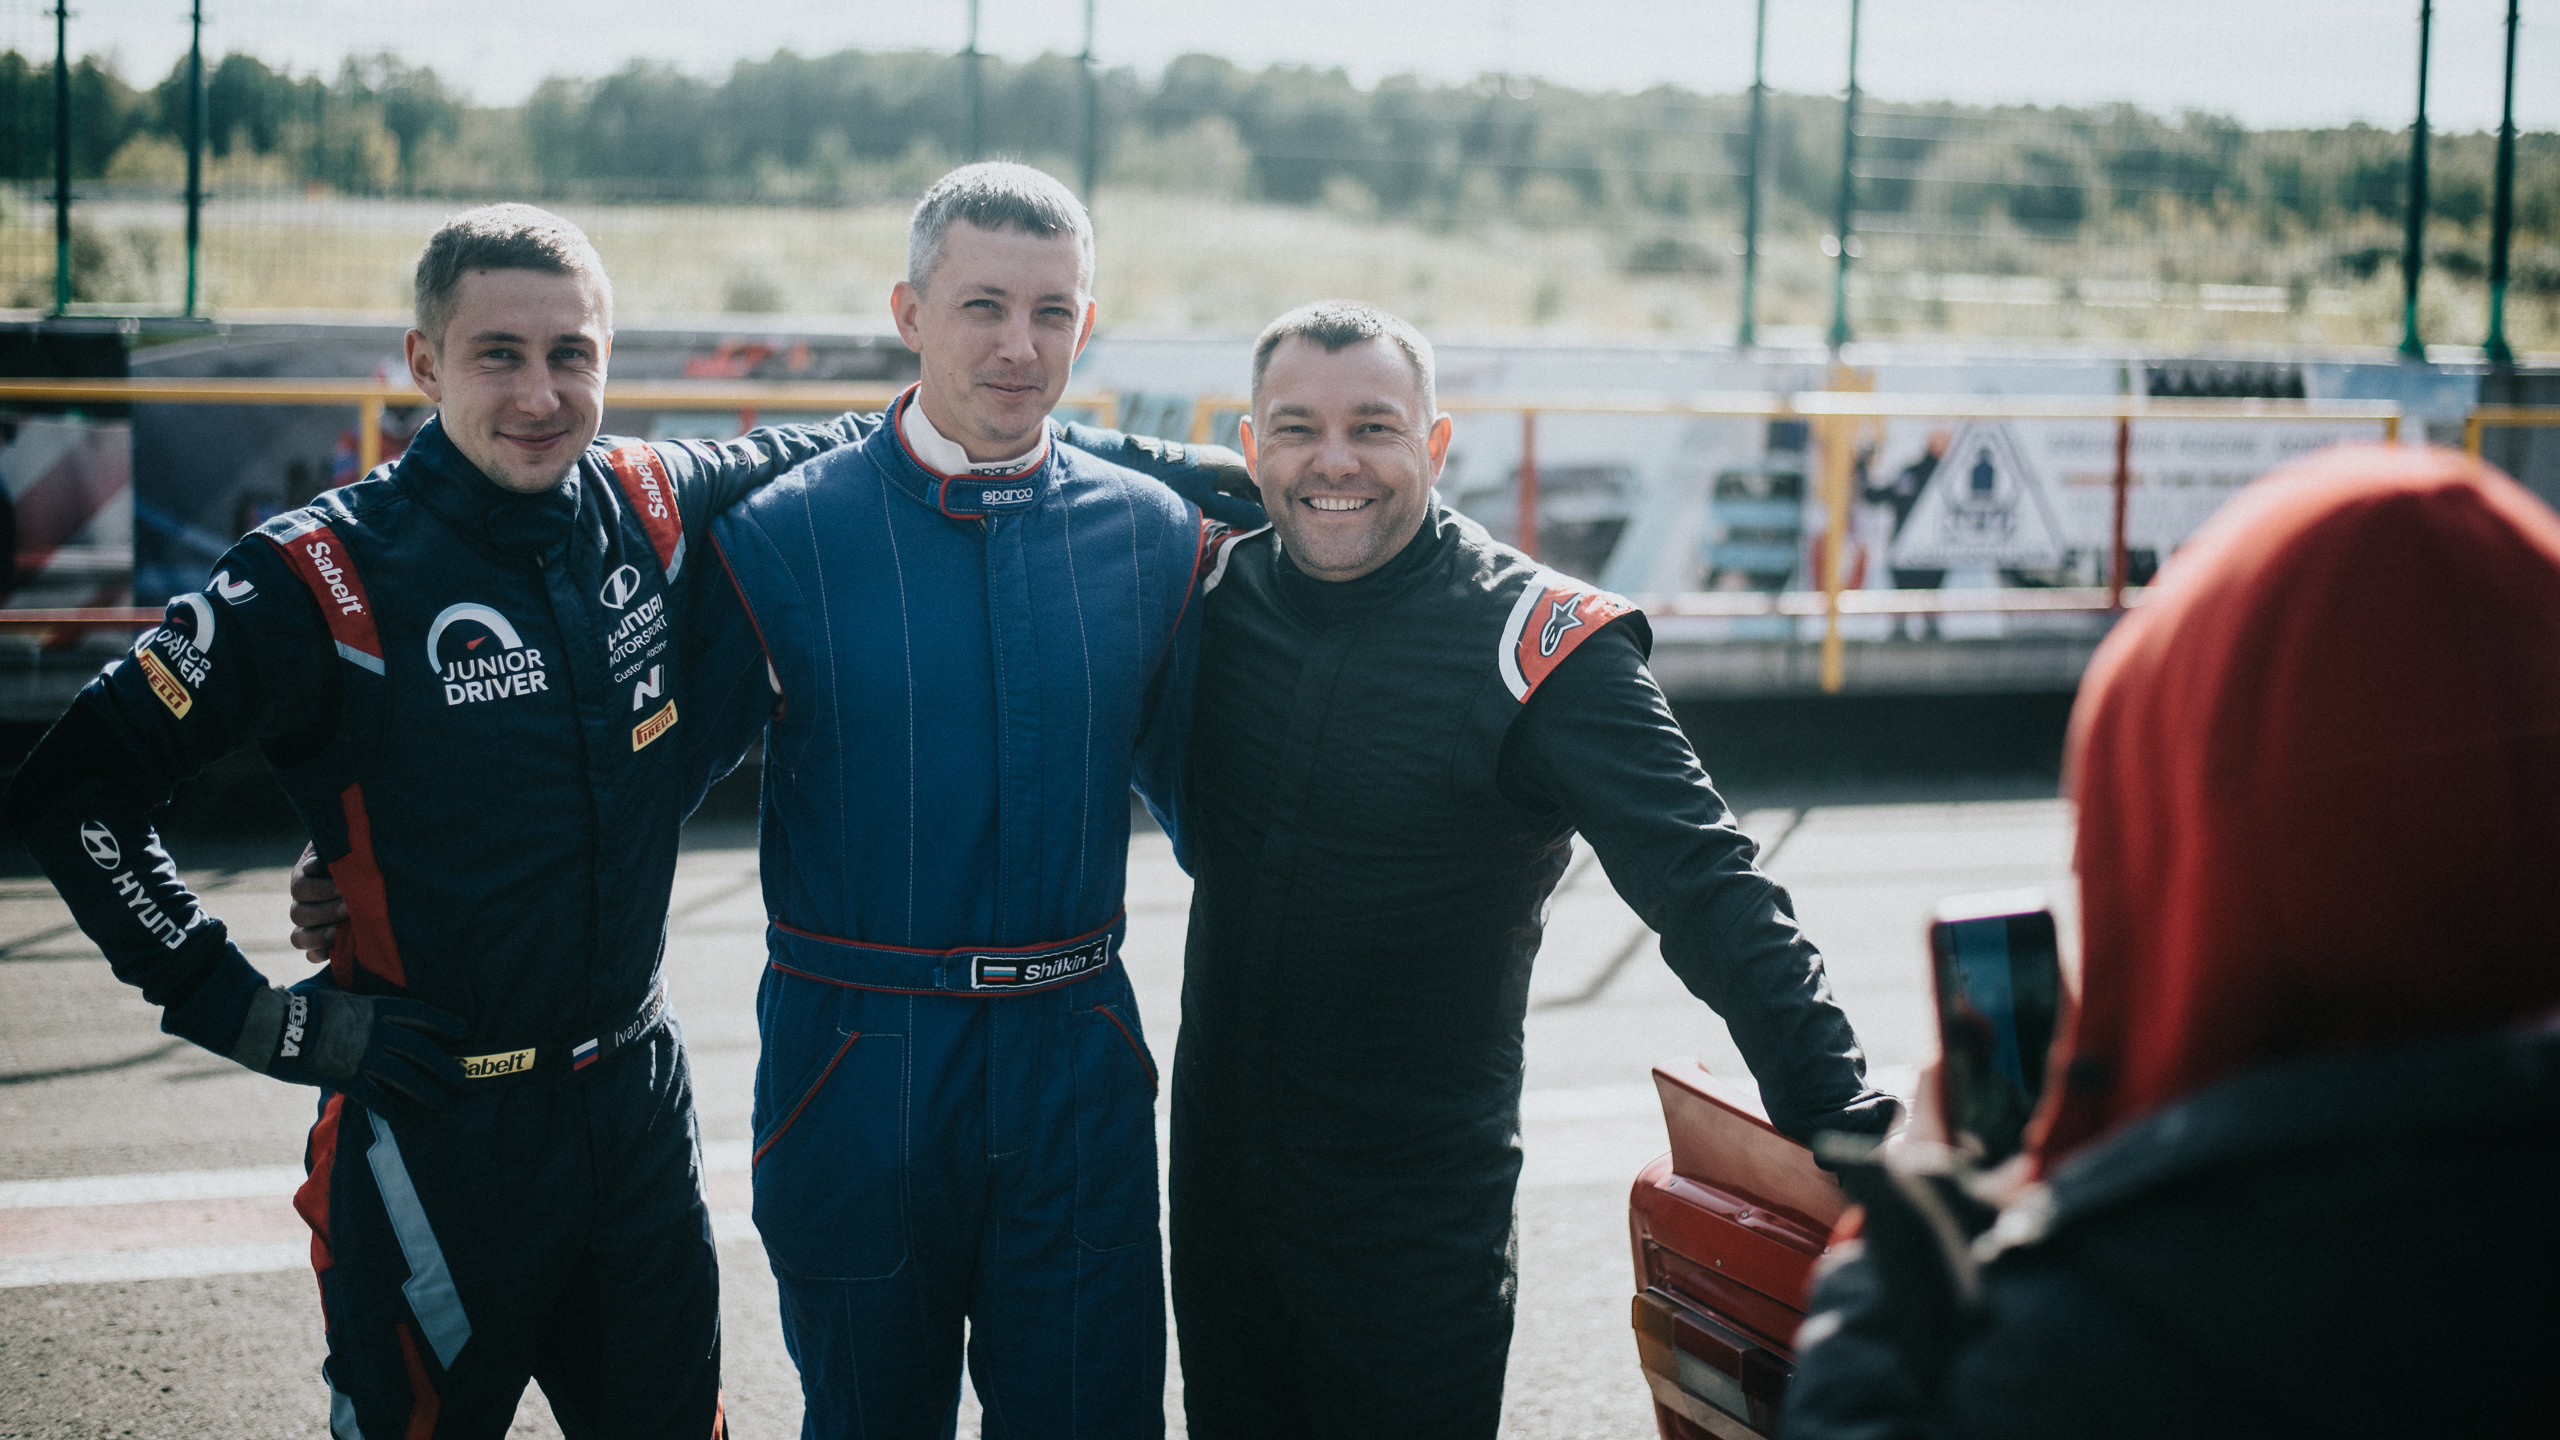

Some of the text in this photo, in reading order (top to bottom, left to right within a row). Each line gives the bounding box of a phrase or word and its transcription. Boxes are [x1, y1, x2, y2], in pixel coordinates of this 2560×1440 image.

[982, 487, 1034, 507] sparco
[306, 541, 364, 616] Sabelt
[608, 593, 663, 652] HUNDAI
[156, 629, 206, 689] DRIER
[443, 648, 546, 683] JUNIOR
[444, 669, 549, 706] DRIVER
[636, 705, 674, 745] PIRELLI
[1024, 954, 1086, 981] Shilkin
[615, 1020, 641, 1048] Ivan
